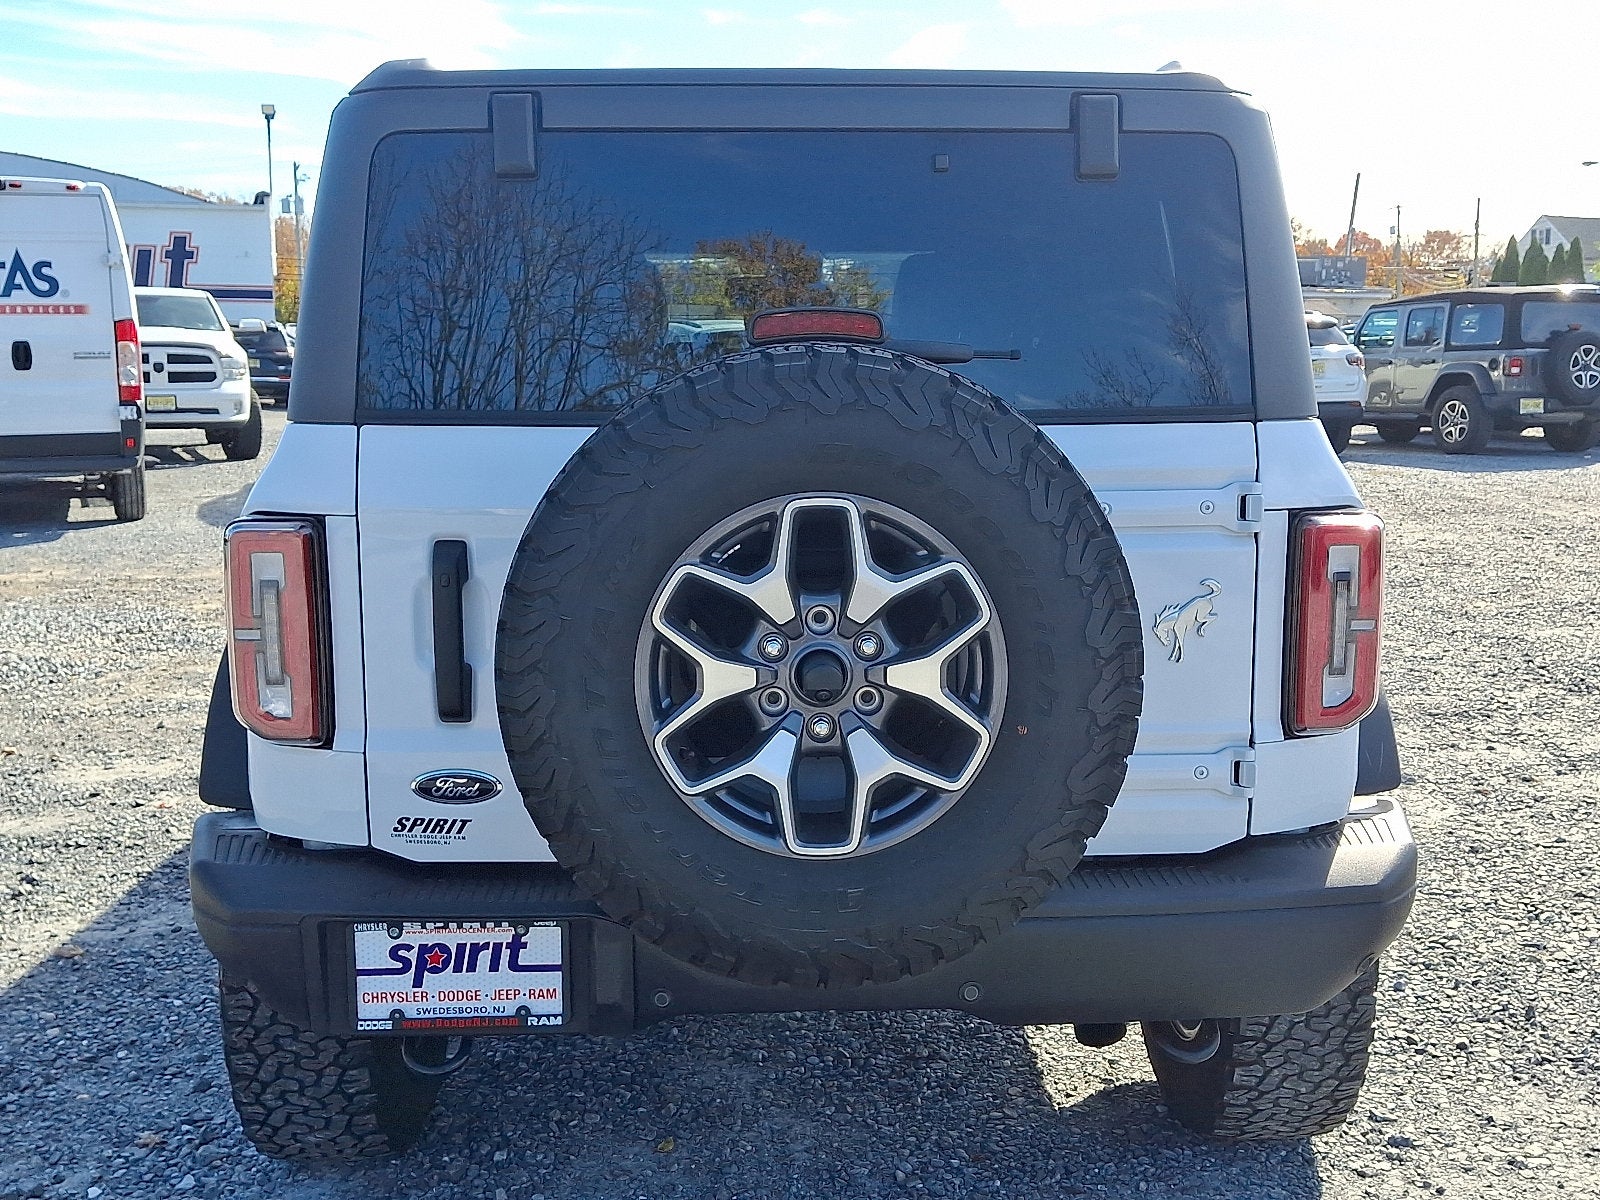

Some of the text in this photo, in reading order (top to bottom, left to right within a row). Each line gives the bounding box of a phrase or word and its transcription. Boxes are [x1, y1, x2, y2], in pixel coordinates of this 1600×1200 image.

[0, 247, 60, 298] AS
[0, 305, 76, 314] ERVICES
[432, 777, 480, 797] Ford
[392, 816, 473, 835] SPIRIT
[353, 922, 388, 932] CHRYSLER
[404, 926, 513, 935] www.SPIRITAUTOCENTER.com
[362, 987, 557, 1004] CHRYSLER DODGE JEEP RAM
[415, 1005, 506, 1016] SWEDESBORO, NJ
[357, 1020, 393, 1031] DODGE
[402, 1017, 519, 1029] www.DodgeNJ.com
[527, 1016, 563, 1026] RAM
